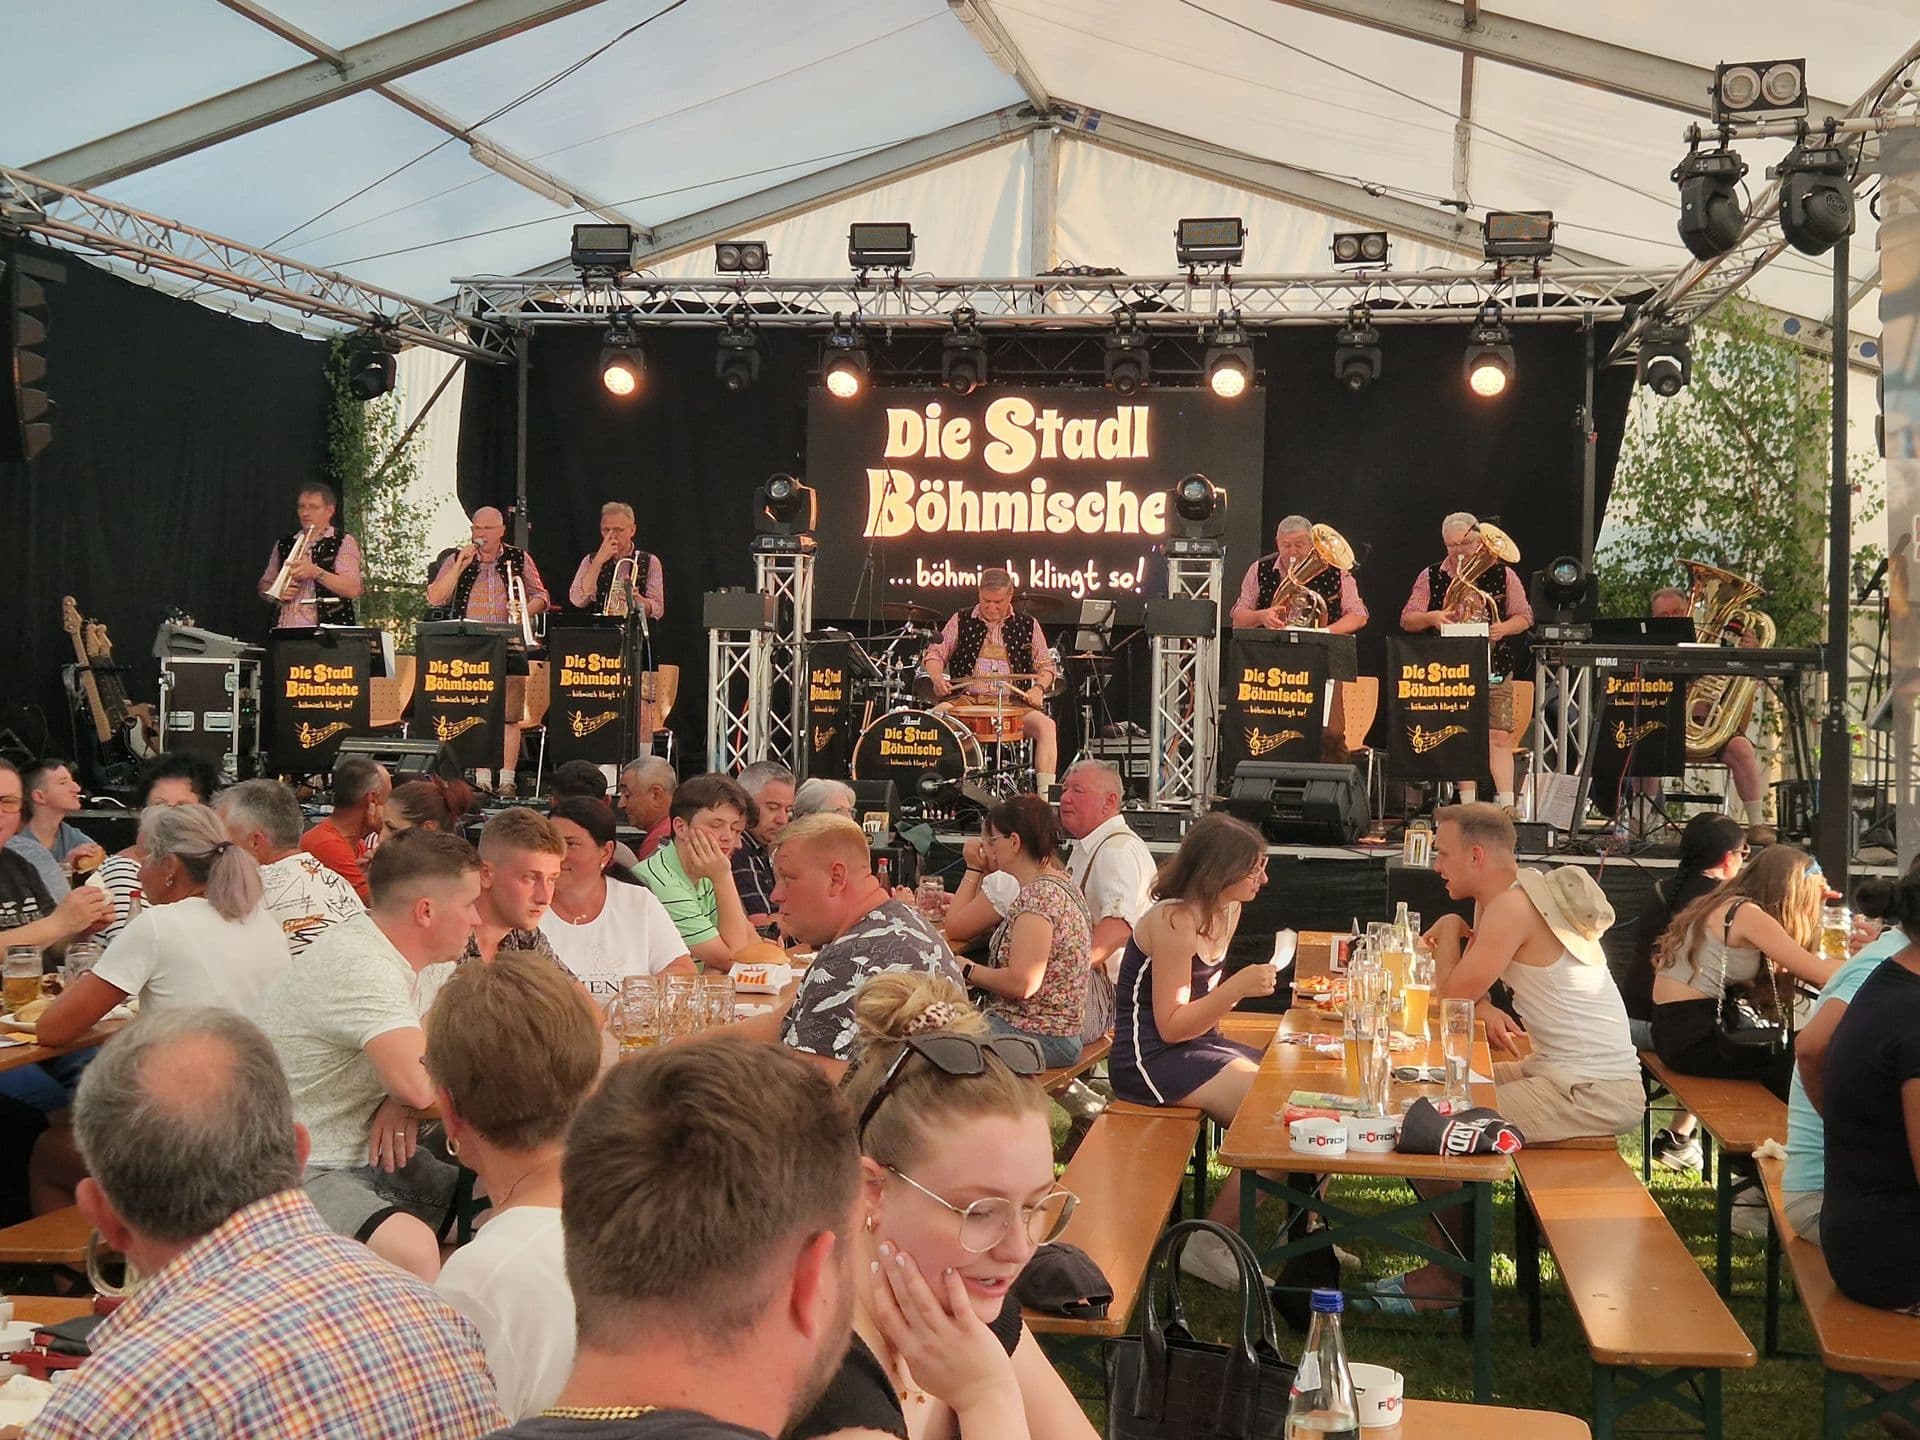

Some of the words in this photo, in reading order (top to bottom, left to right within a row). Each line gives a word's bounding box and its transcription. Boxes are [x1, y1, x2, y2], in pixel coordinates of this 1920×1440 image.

[884, 403, 971, 460] Die
[984, 397, 1149, 474] Stadl
[863, 468, 1167, 538] Böhmische
[889, 558, 1019, 588] ...böhmih
[1030, 559, 1100, 598] klingt
[1109, 556, 1145, 594] so!
[429, 660, 449, 674] Die
[450, 659, 489, 677] Stadl
[565, 655, 586, 668] Die
[1596, 657, 1618, 667] KORG
[290, 665, 312, 680] Die
[313, 664, 353, 683] Stadl
[1243, 668, 1265, 683] Die
[1267, 667, 1309, 687] Stadl
[1402, 664, 1425, 679] Die
[1427, 662, 1470, 683] Stadl
[286, 680, 359, 698] Böhmische
[425, 674, 494, 691] Böhmische
[1398, 680, 1476, 698] Böhmische
[1238, 682, 1313, 704] Böhmische
[884, 727, 903, 739] Die
[904, 726, 938, 743] Stadl
[880, 740, 942, 756] Böhmische
